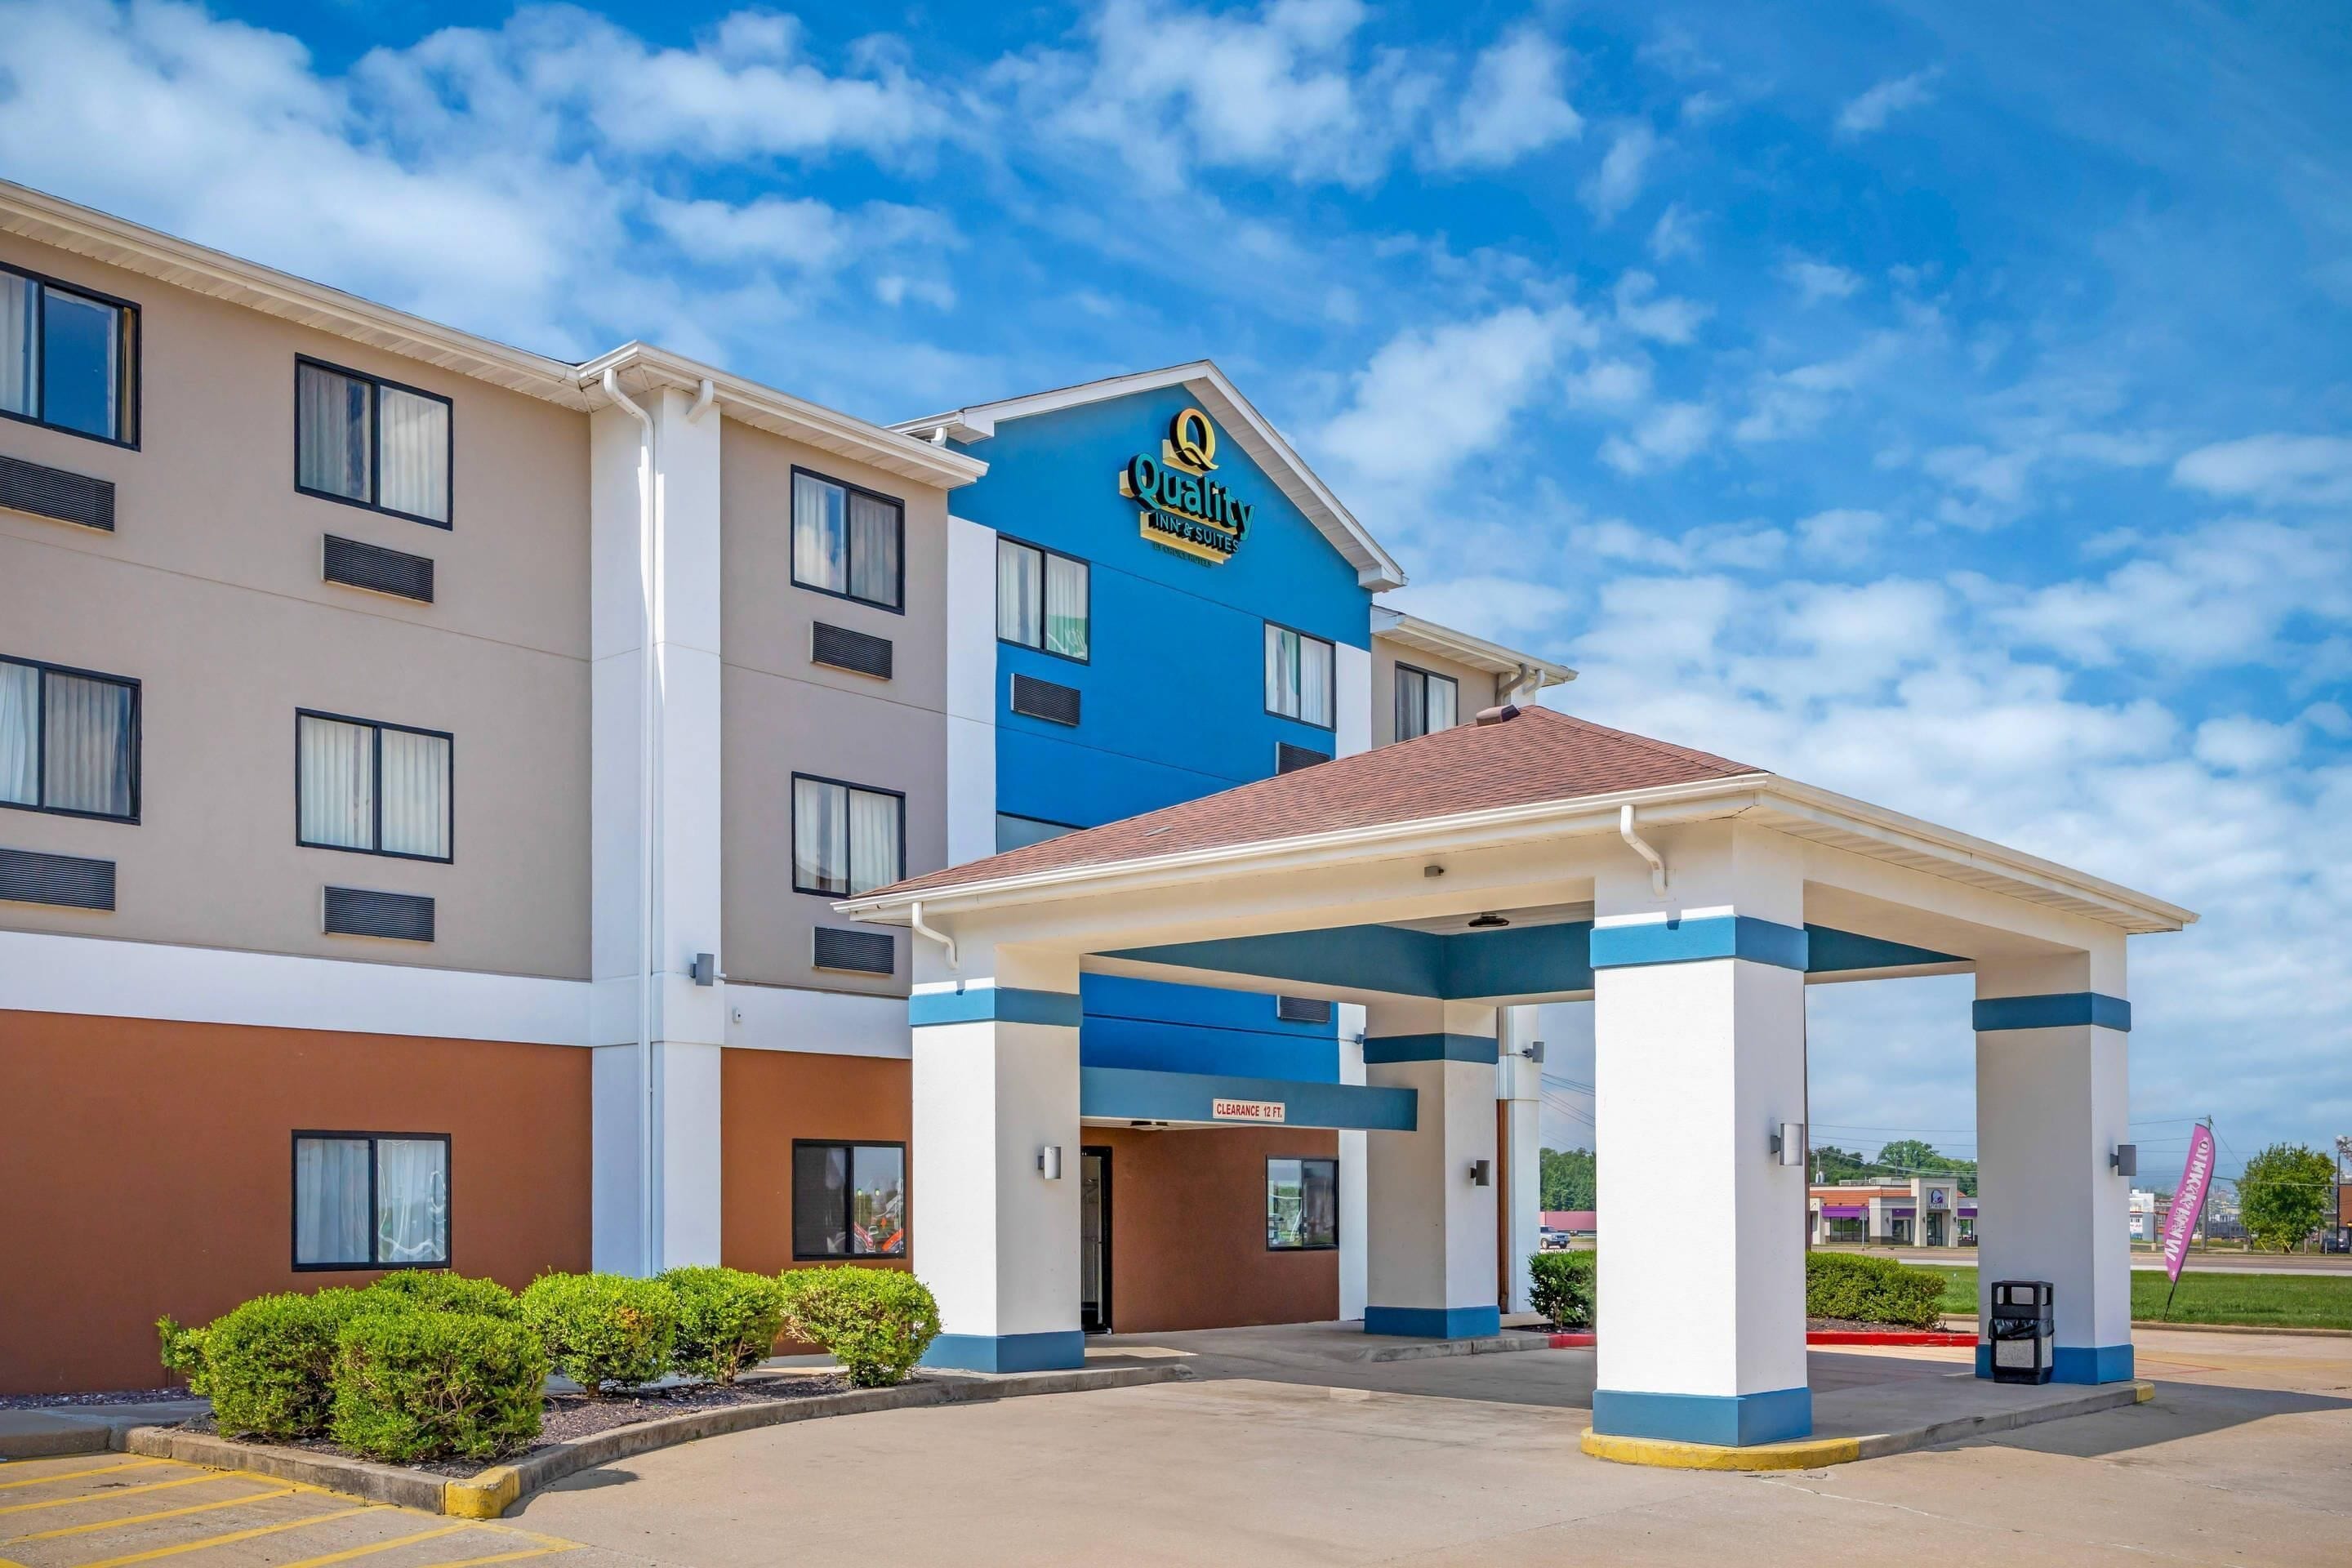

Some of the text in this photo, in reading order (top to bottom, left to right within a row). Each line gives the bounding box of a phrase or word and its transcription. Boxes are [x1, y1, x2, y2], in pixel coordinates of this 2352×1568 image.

[1170, 408, 1218, 470] Q
[1128, 452, 1254, 541] Quality
[1154, 512, 1179, 532] INN
[1196, 527, 1240, 553] SUITES
[1217, 1103, 1282, 1118] CLEARANCE 12 FT.
